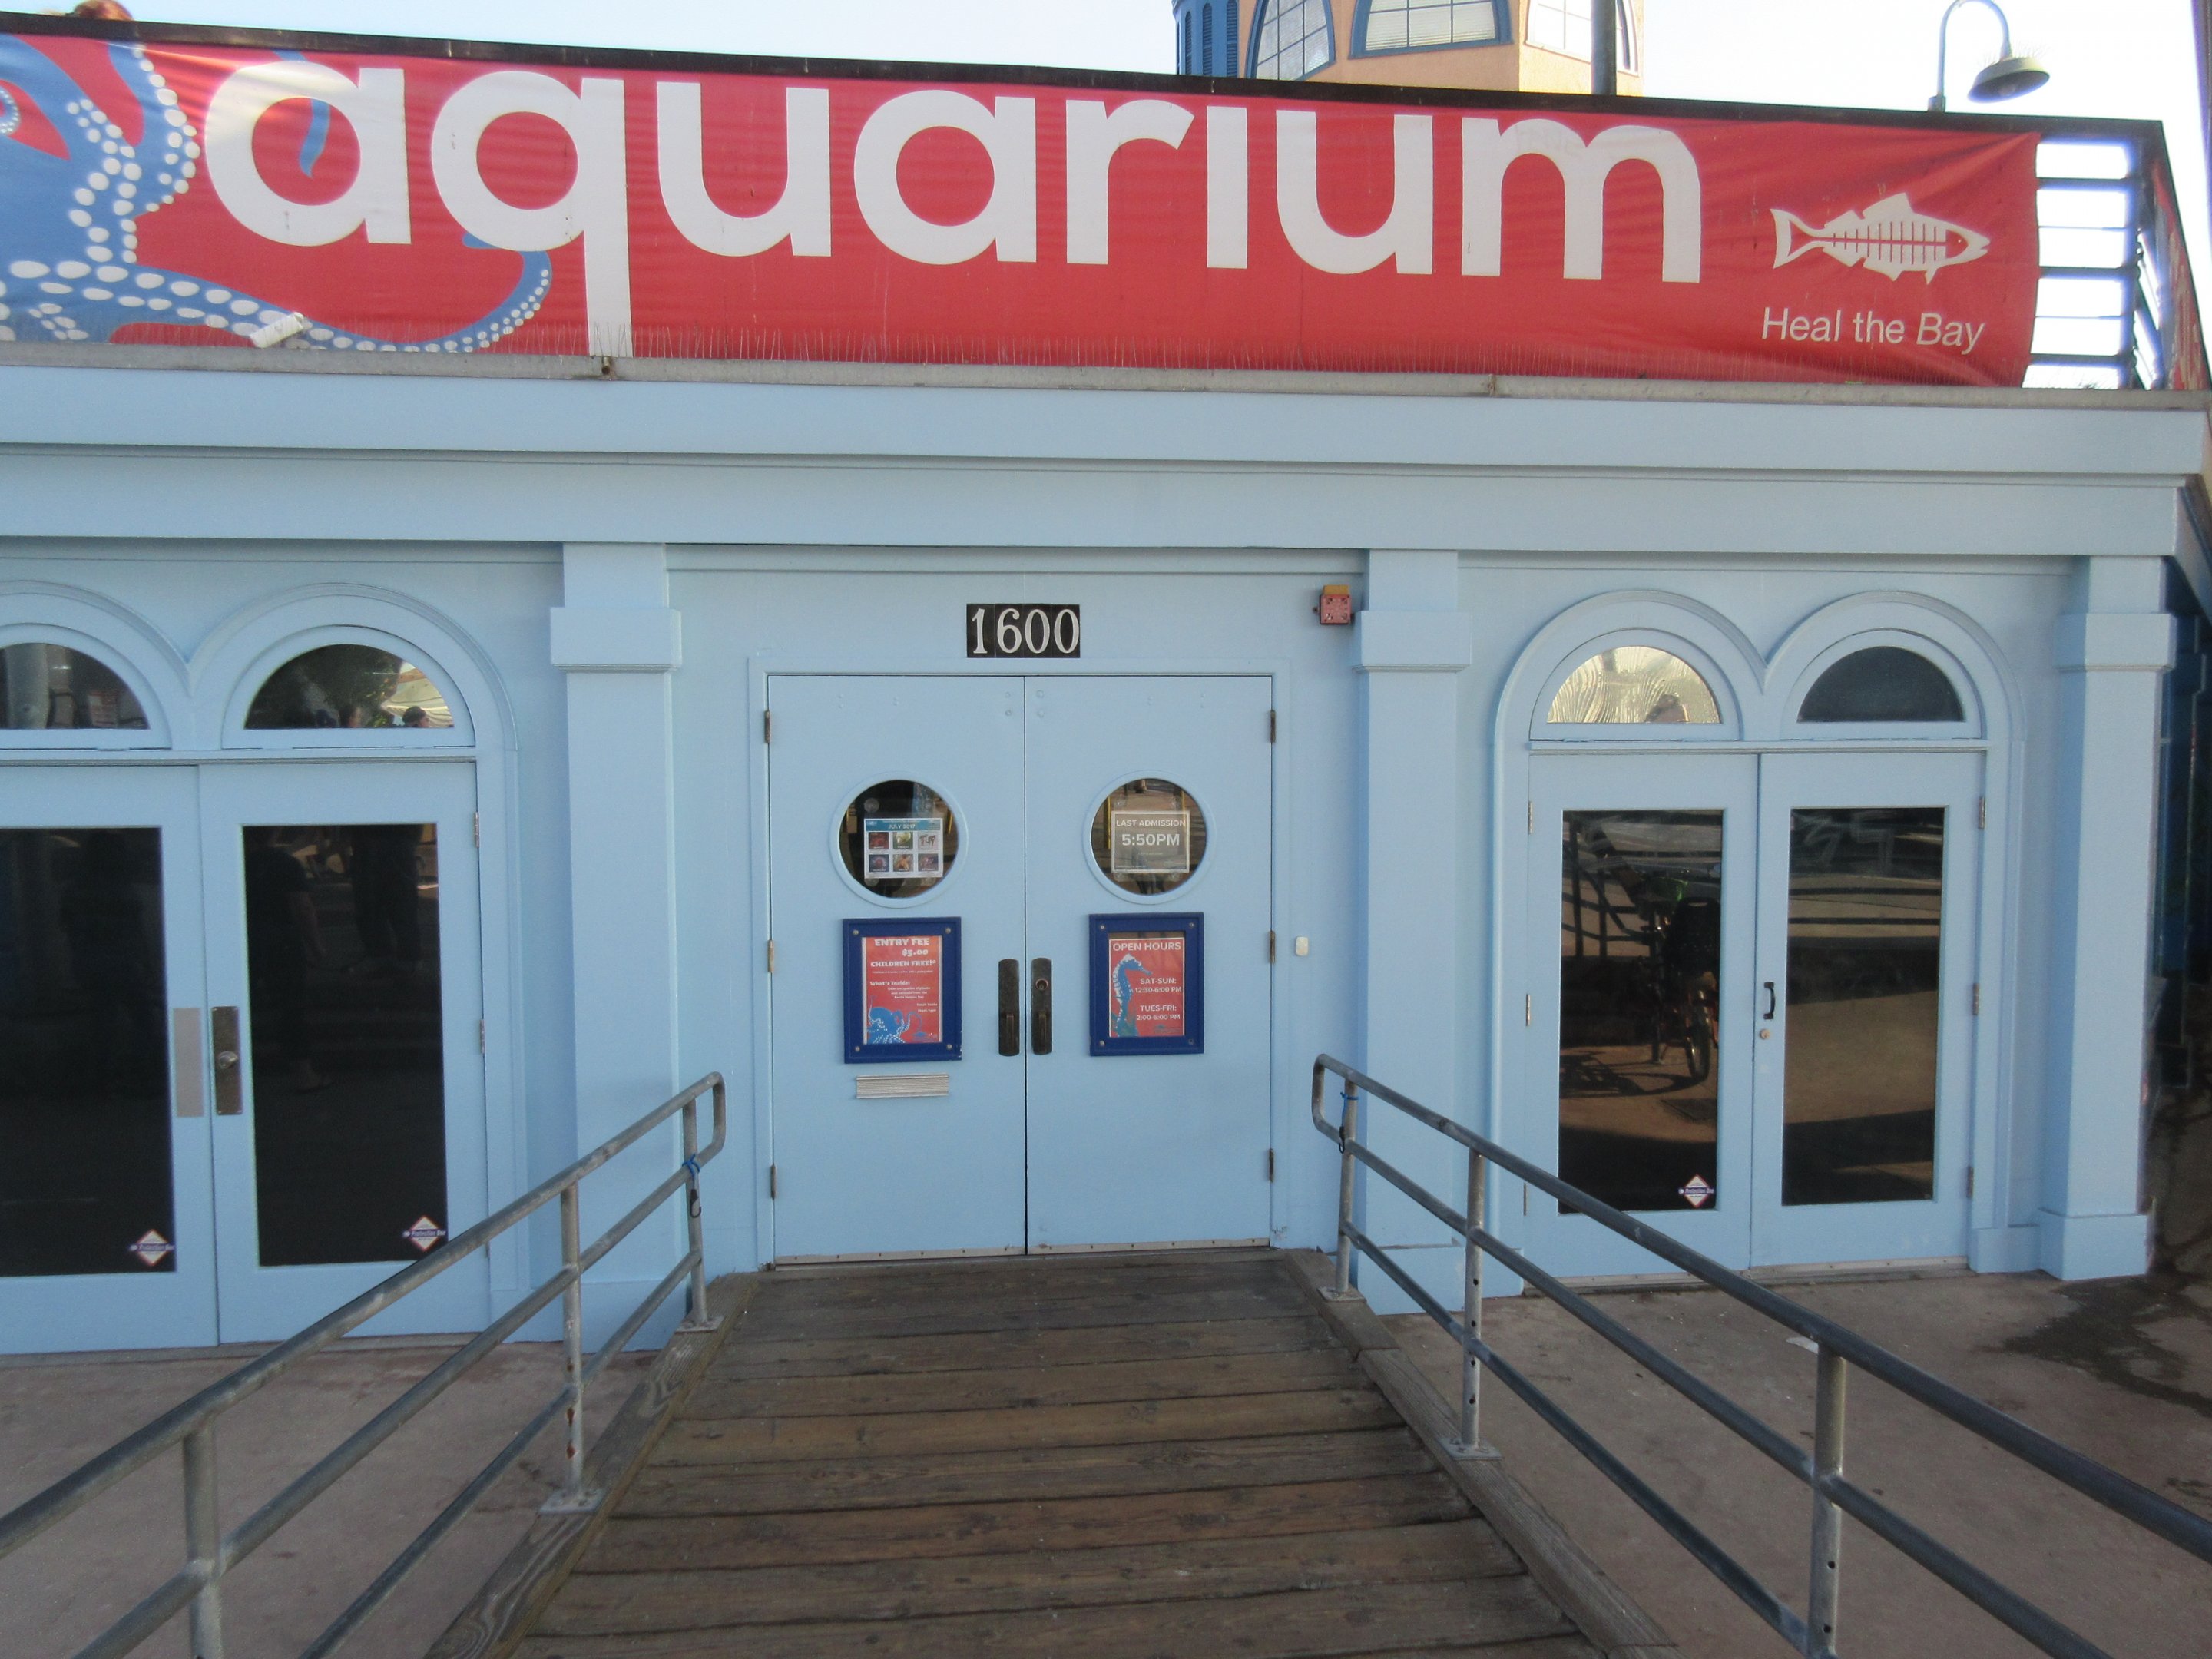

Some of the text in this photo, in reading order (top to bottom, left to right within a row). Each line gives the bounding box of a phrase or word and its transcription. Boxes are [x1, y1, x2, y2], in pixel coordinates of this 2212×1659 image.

[204, 60, 1702, 357] aquarium
[1762, 306, 1986, 356] Heal the Bay
[972, 608, 1080, 654] 1600
[1121, 833, 1180, 846] 5:50PM
[874, 938, 909, 947] ENTRY
[1113, 942, 1181, 952] OPEN HOURS
[902, 948, 929, 957] $5.00
